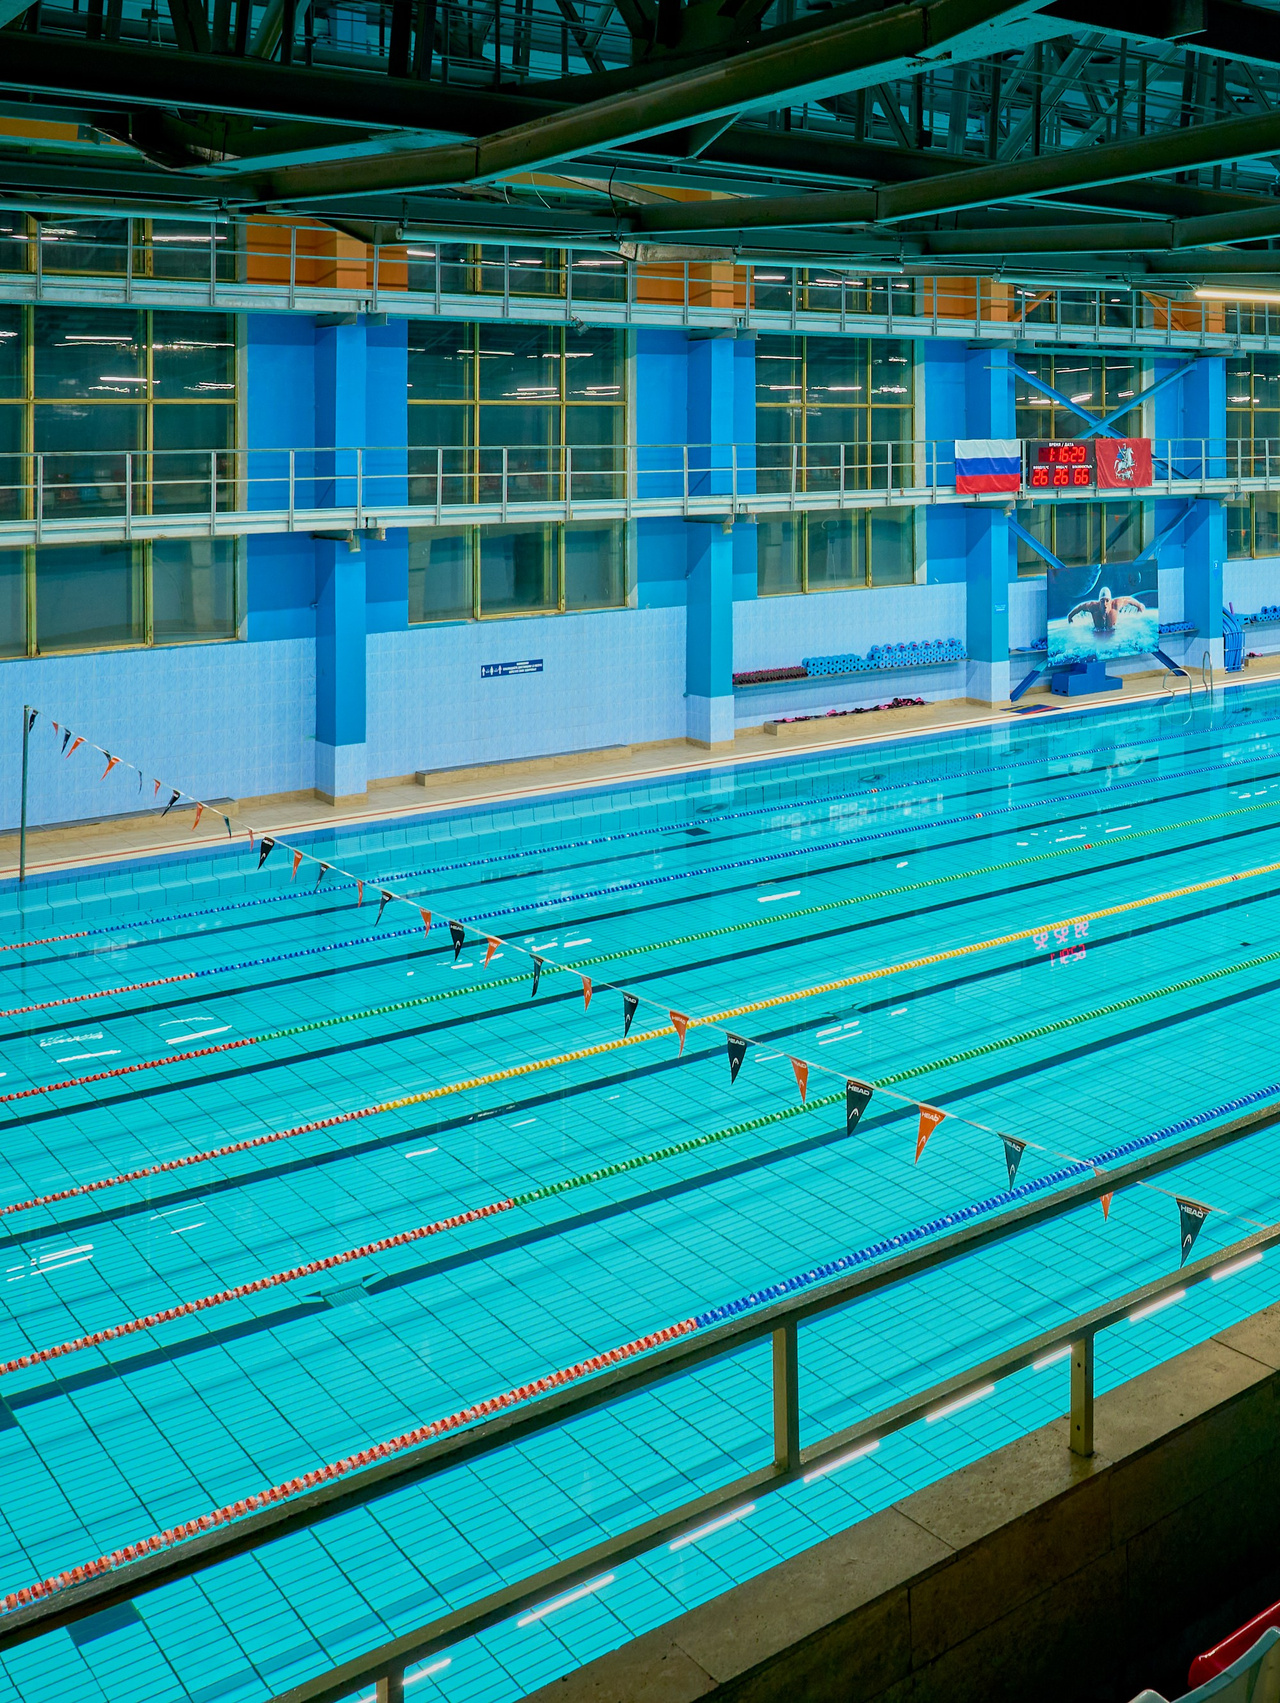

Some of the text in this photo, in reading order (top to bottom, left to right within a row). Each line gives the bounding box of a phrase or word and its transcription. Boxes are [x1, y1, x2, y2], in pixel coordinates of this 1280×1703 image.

[1033, 468, 1090, 486] 26 26 66
[671, 1015, 686, 1025] HEAD
[728, 1037, 745, 1046] HEAD
[848, 1084, 871, 1097] HEAD
[921, 1112, 941, 1122] HEAD
[1180, 1205, 1204, 1219] HEAD
